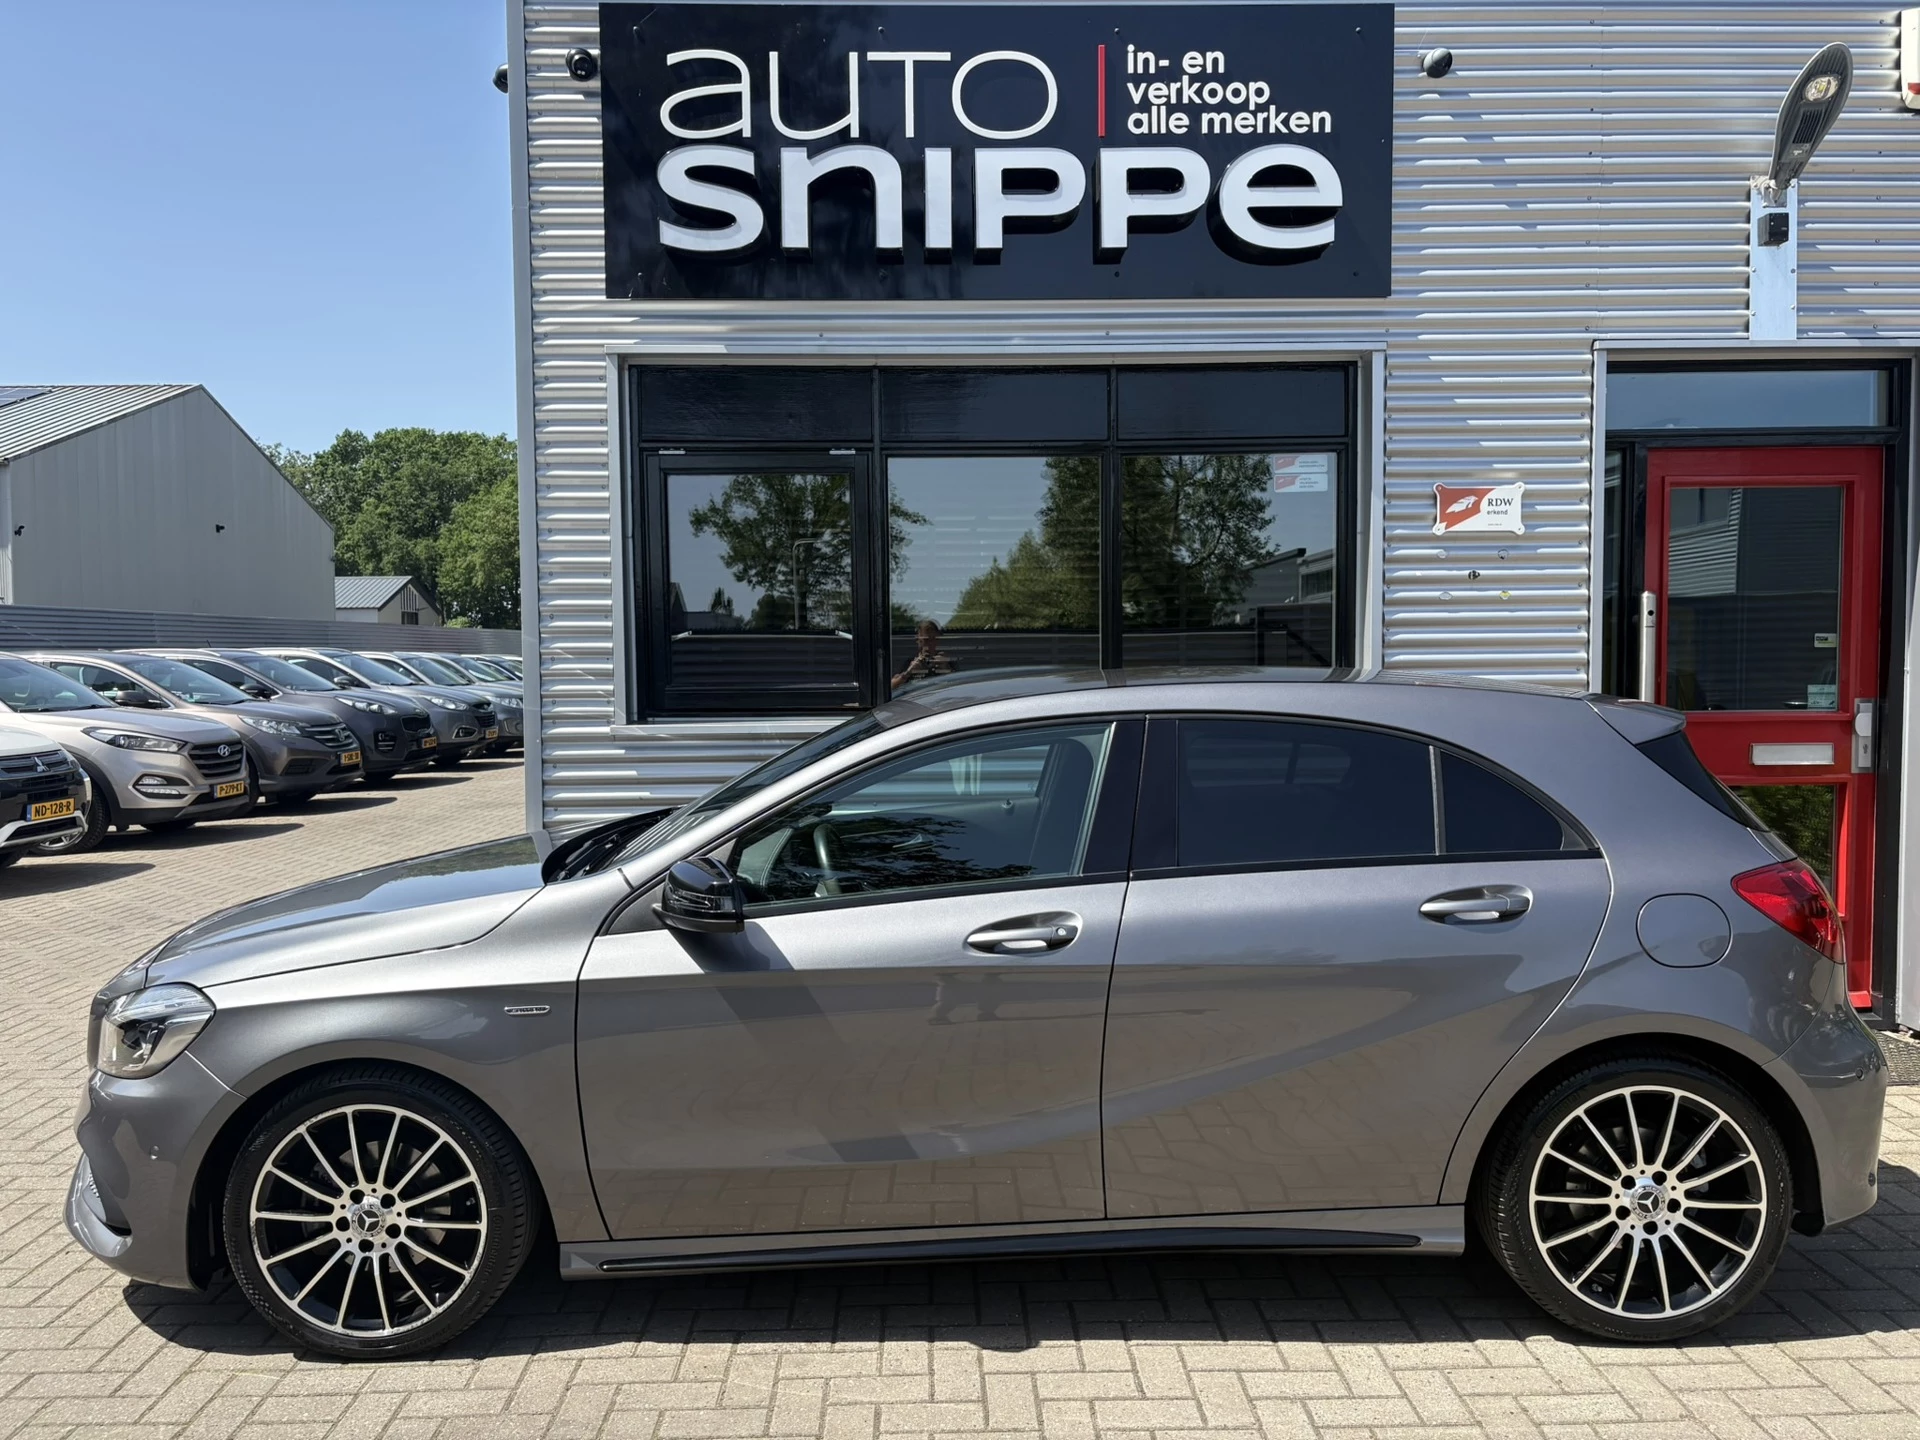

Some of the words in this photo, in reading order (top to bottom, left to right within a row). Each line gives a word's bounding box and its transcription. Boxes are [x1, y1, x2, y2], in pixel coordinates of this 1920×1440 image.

[1127, 44, 1170, 74] in-
[1182, 51, 1225, 74] en
[1126, 75, 1271, 111] verkoop
[1127, 105, 1190, 135] alle
[1200, 104, 1333, 134] merken
[1487, 498, 1514, 507] RDW
[34, 801, 72, 818] ND-128-R
